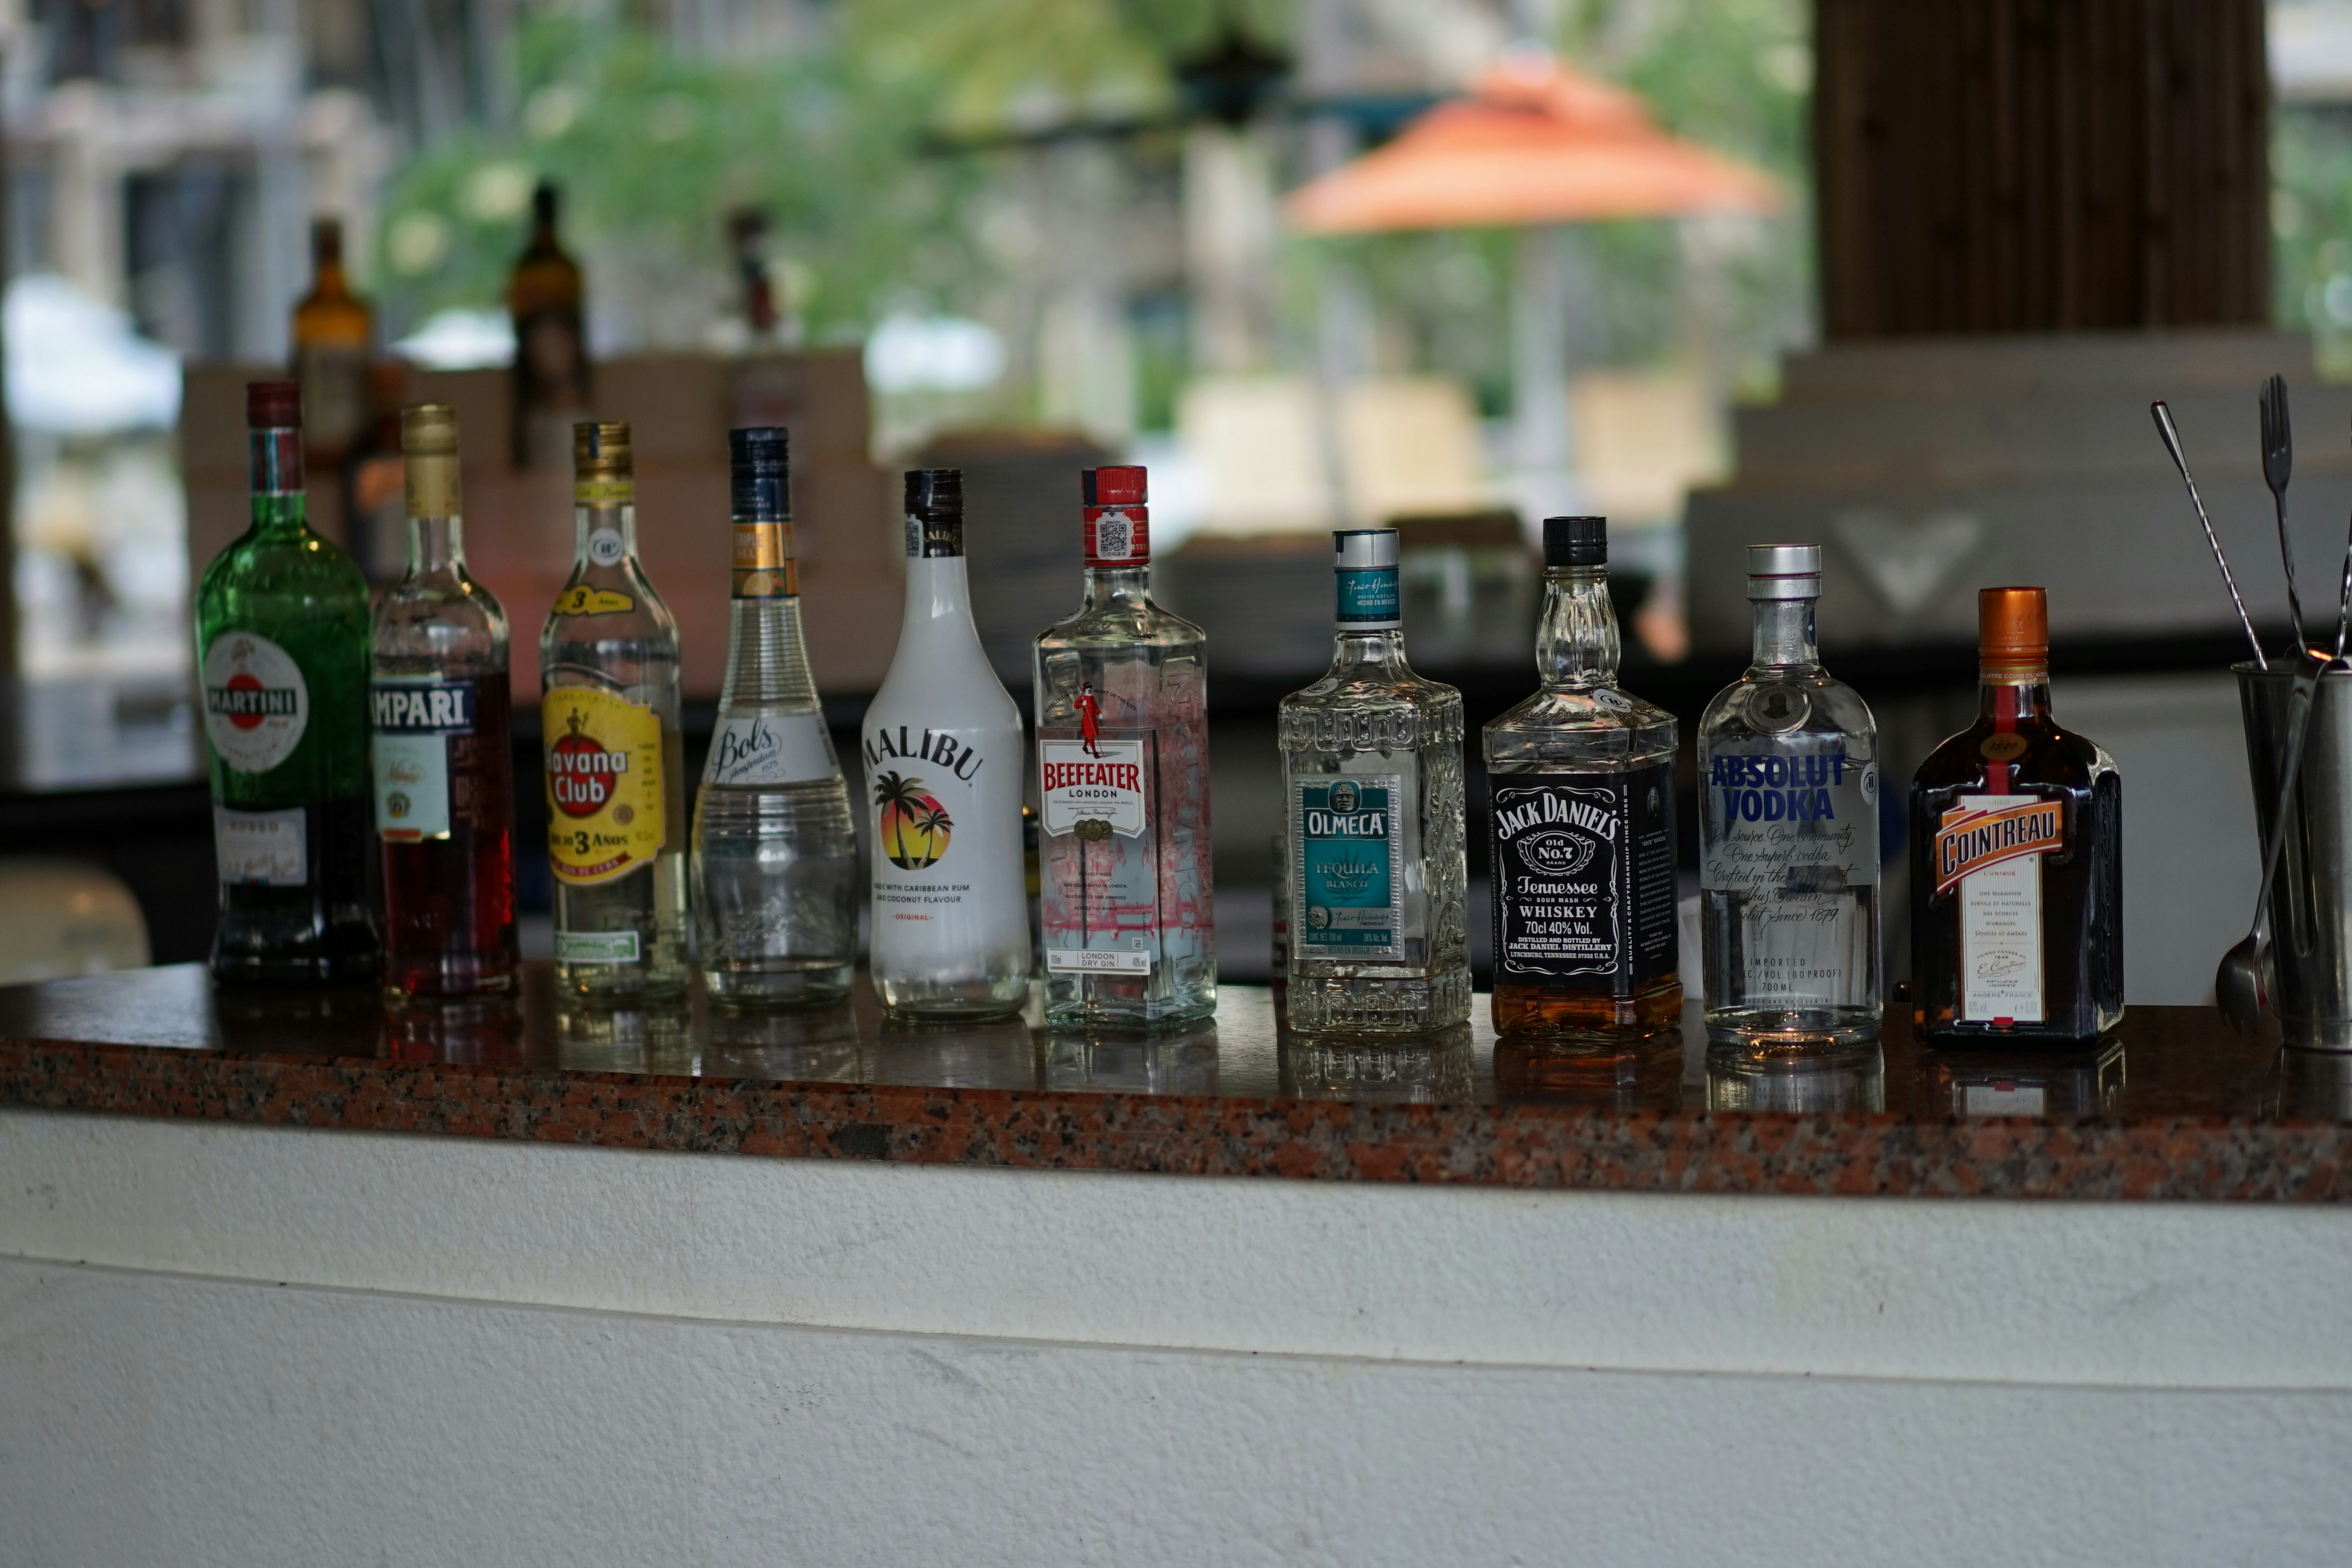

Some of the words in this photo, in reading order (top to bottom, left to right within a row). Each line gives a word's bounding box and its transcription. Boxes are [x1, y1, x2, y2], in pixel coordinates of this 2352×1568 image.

[572, 591, 586, 608] 3
[210, 690, 292, 713] MARTINI
[372, 689, 464, 727] MPARI
[712, 718, 774, 780] Bols
[864, 725, 983, 781] MALIBU
[727, 749, 777, 781] Amsterdam
[762, 760, 778, 771] 1575
[1712, 754, 1845, 788] ABSOLUT
[555, 776, 605, 803] Club
[1043, 762, 1141, 794] BEEFEATER
[1069, 789, 1117, 798] LONDON
[1722, 788, 1835, 822] VODKA
[1309, 812, 1384, 835] OLMECA
[1496, 801, 1543, 840] JACK
[1543, 793, 1621, 841] DANIEL'S
[574, 831, 590, 855] 3
[1767, 824, 1795, 845] One
[1942, 810, 2056, 877] COINTREAU
[1723, 843, 1753, 862] One
[593, 859, 619, 873] CUBA
[1314, 862, 1380, 878] TEQUILA
[1707, 860, 1750, 890] Crafted
[1752, 871, 1765, 883] in
[1764, 863, 1787, 883] the
[1517, 876, 1598, 894] Tennessee
[1519, 906, 1597, 918] WHISKEY
[1525, 921, 1546, 934] 70cl
[1549, 921, 1572, 935] 40%
[1573, 922, 1592, 935] Vol.
[1750, 958, 1805, 967] IMPORTED
